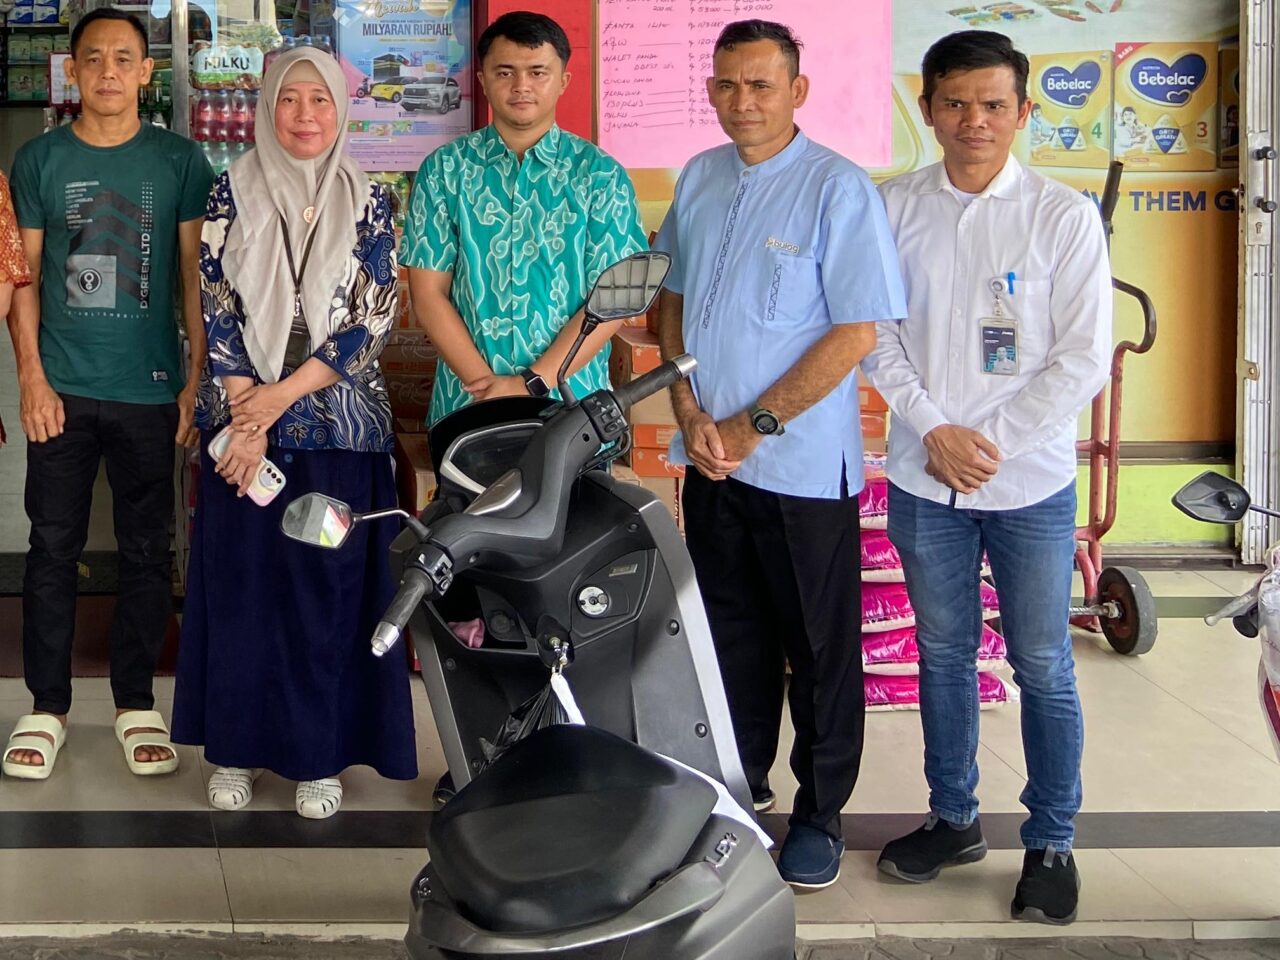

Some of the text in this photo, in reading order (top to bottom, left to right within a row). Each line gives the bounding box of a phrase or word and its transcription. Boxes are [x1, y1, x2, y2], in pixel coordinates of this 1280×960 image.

[362, 23, 452, 36] MILYARAN RUPIAH!
[1047, 77, 1092, 90] Bebelac
[1138, 71, 1195, 86] Bebelac
[1091, 122, 1102, 139] 4
[1197, 121, 1208, 138] 3
[1129, 191, 1206, 211] THEM
[141, 232, 151, 255] LTD
[773, 240, 799, 254] bulog
